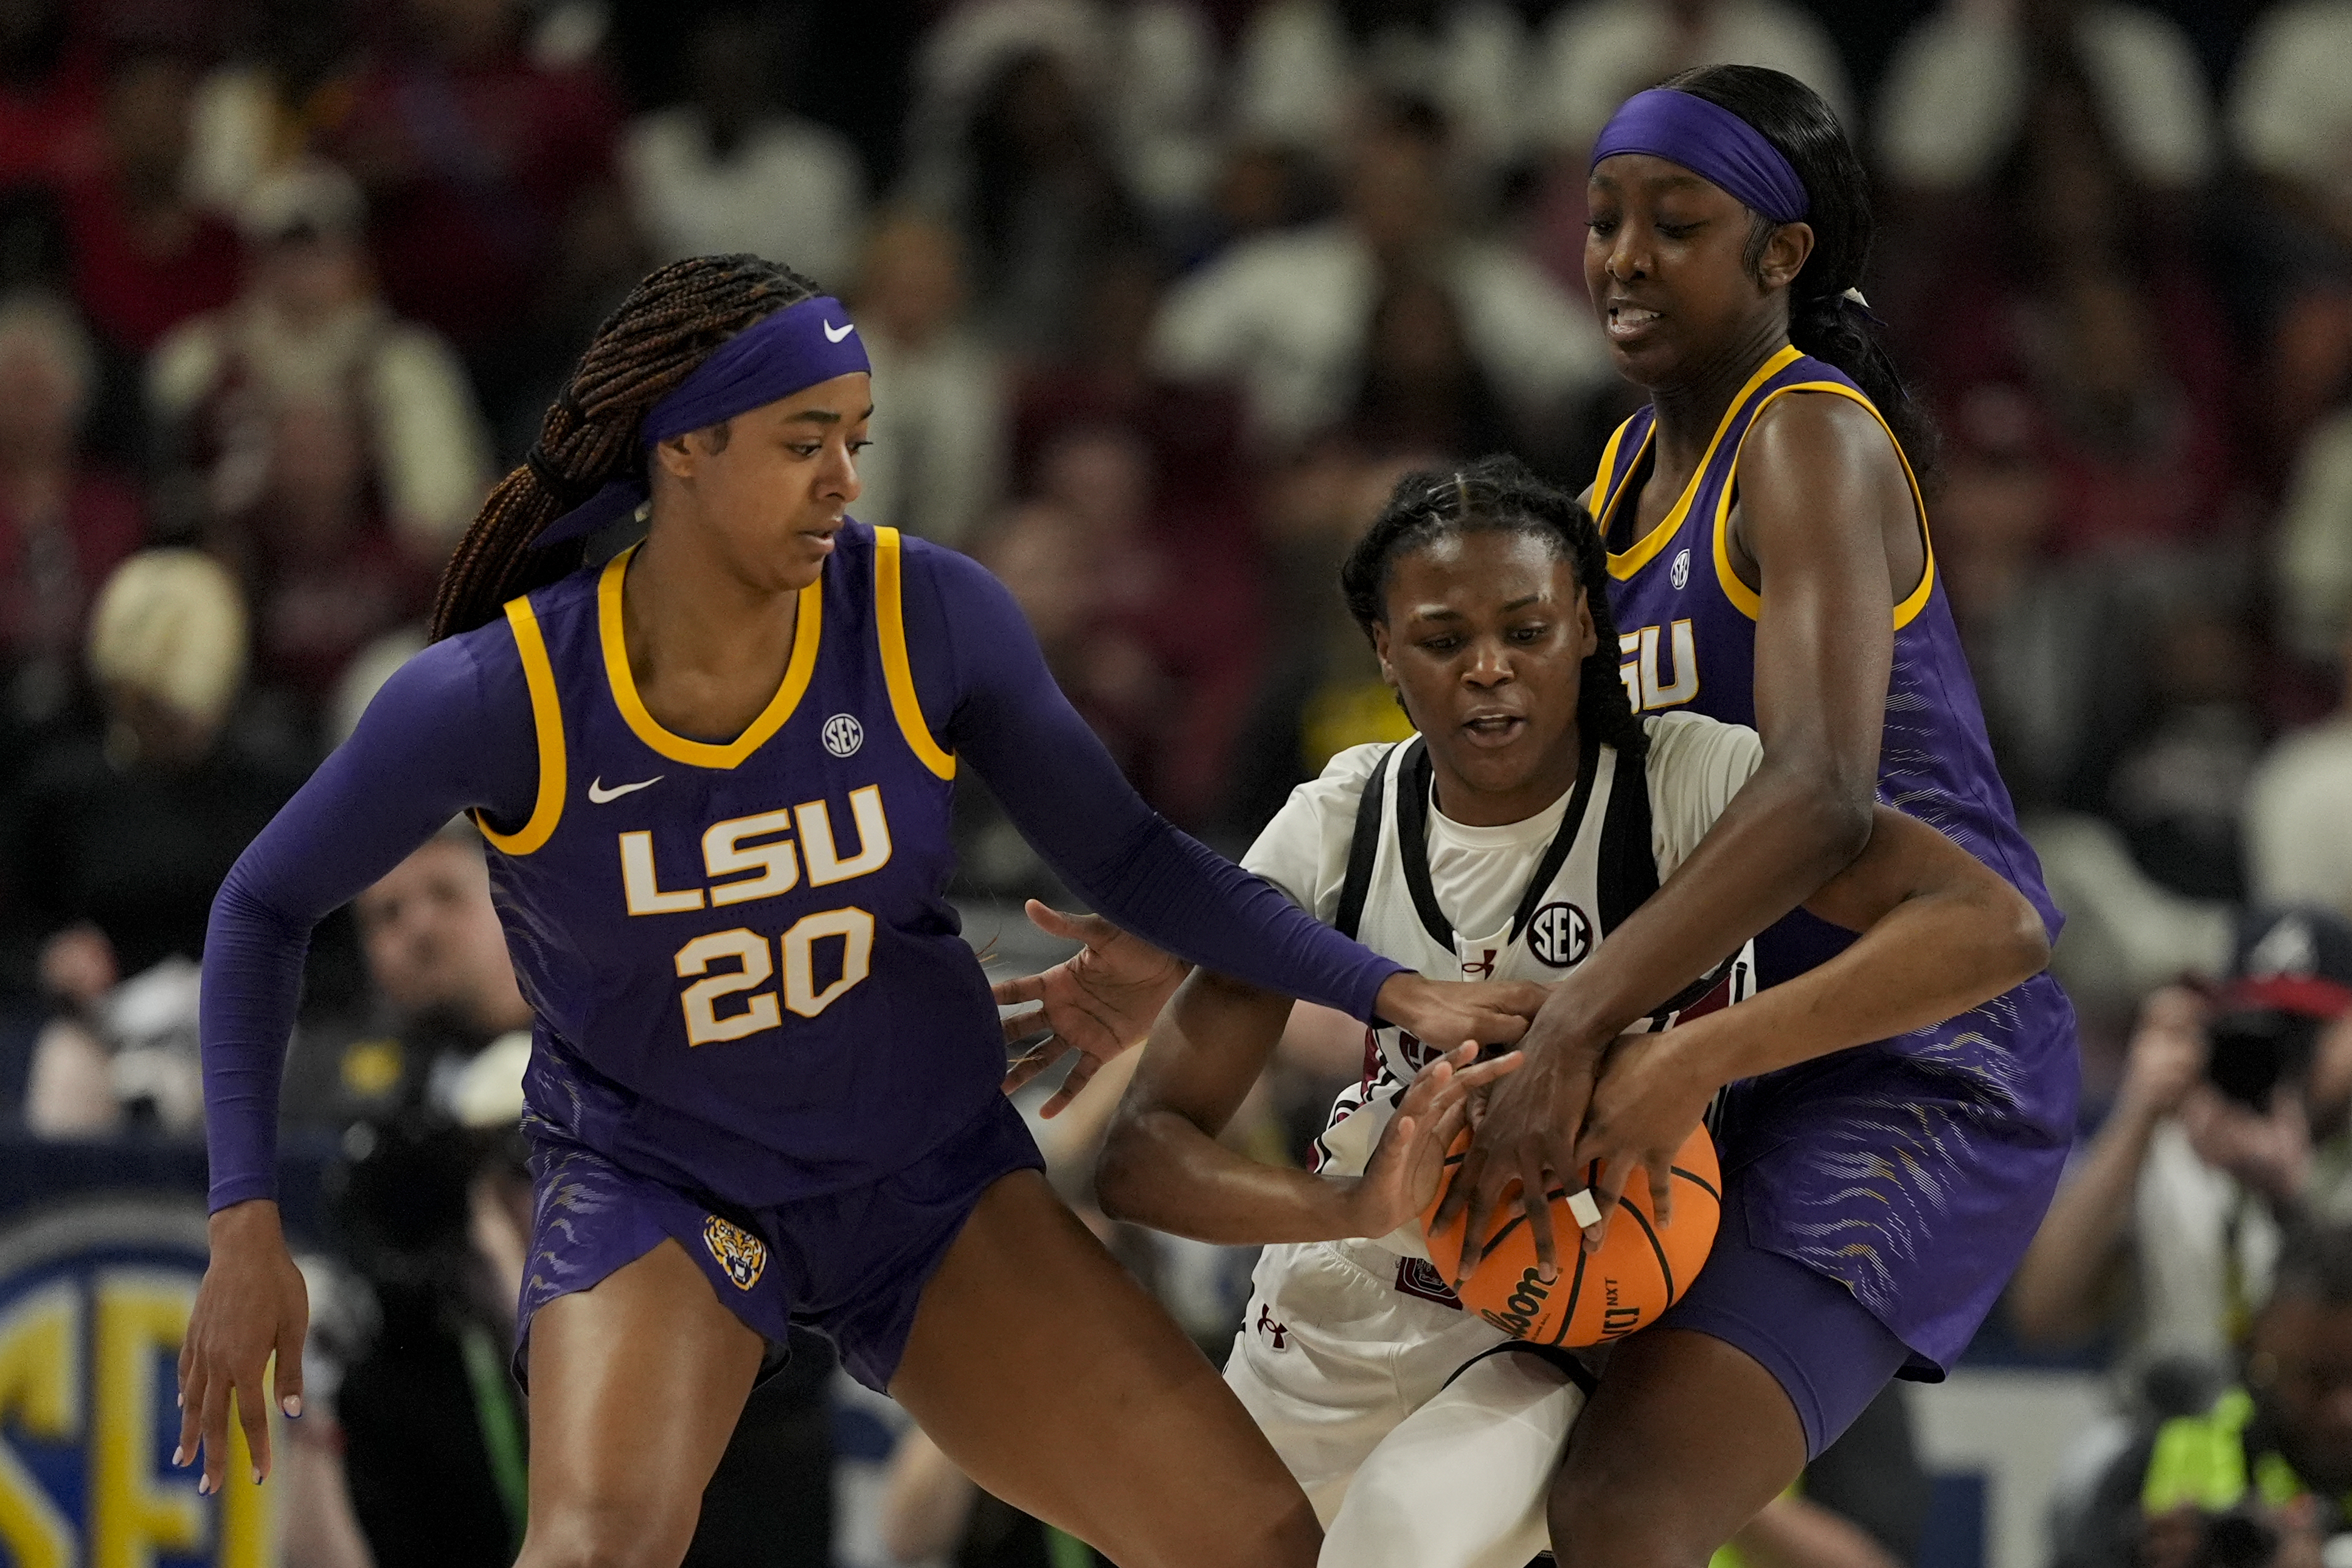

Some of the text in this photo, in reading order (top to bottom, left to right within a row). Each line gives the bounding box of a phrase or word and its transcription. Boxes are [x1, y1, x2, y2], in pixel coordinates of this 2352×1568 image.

[1672, 550, 1688, 588] SEC
[825, 717, 859, 754] SEC
[619, 784, 892, 916] LSU
[1533, 907, 1586, 963] SEC
[674, 906, 875, 1047] 20
[1480, 1267, 1560, 1337] lson
[1604, 1277, 1618, 1306] NXT
